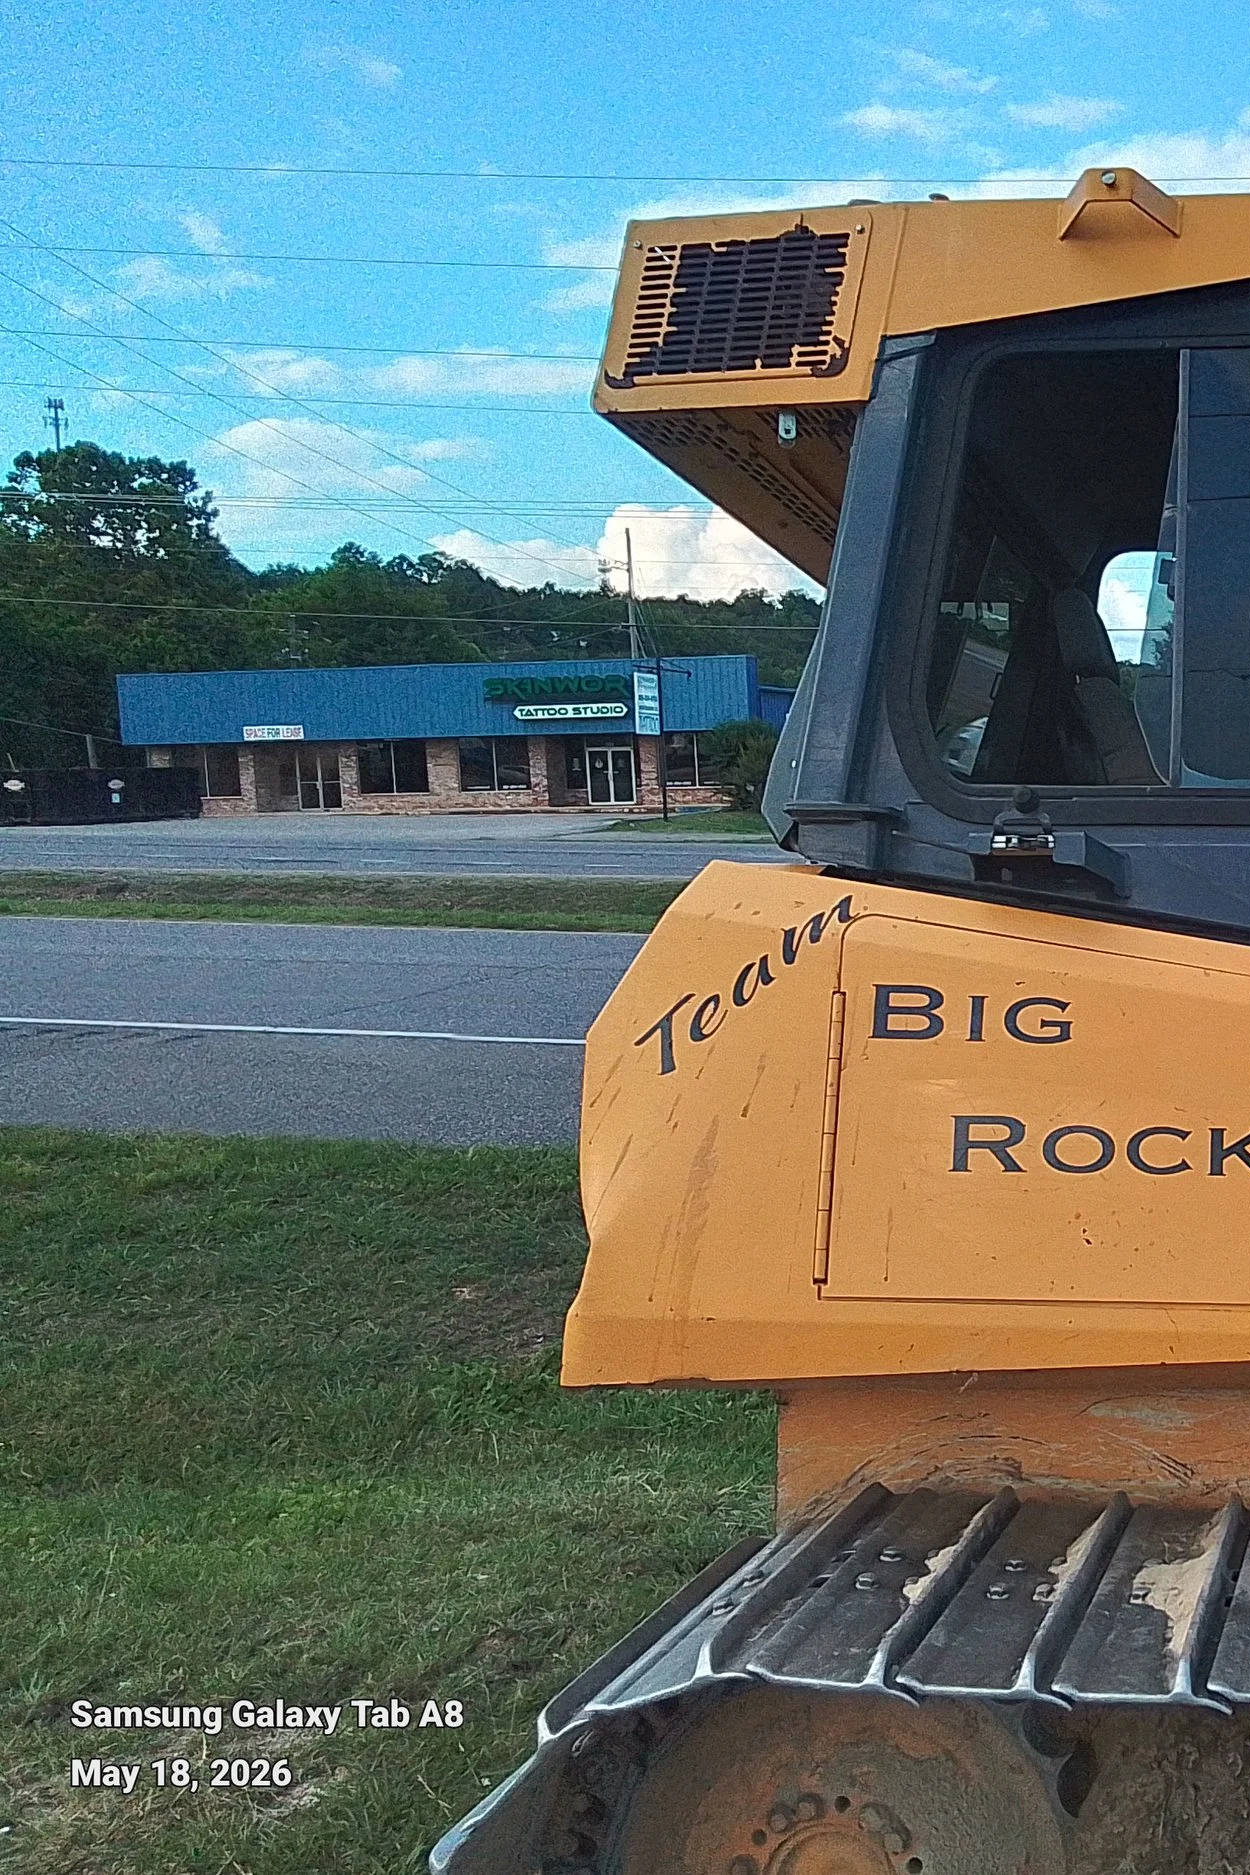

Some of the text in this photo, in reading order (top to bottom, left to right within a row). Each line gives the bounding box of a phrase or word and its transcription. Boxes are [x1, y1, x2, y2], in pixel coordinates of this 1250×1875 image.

[484, 675, 632, 700] SKINWOR
[518, 705, 624, 717] TATTOO STUDIO
[245, 727, 302, 739] SPACE FOR LEASE
[634, 894, 858, 1076] Team
[867, 983, 1074, 1045] BIG
